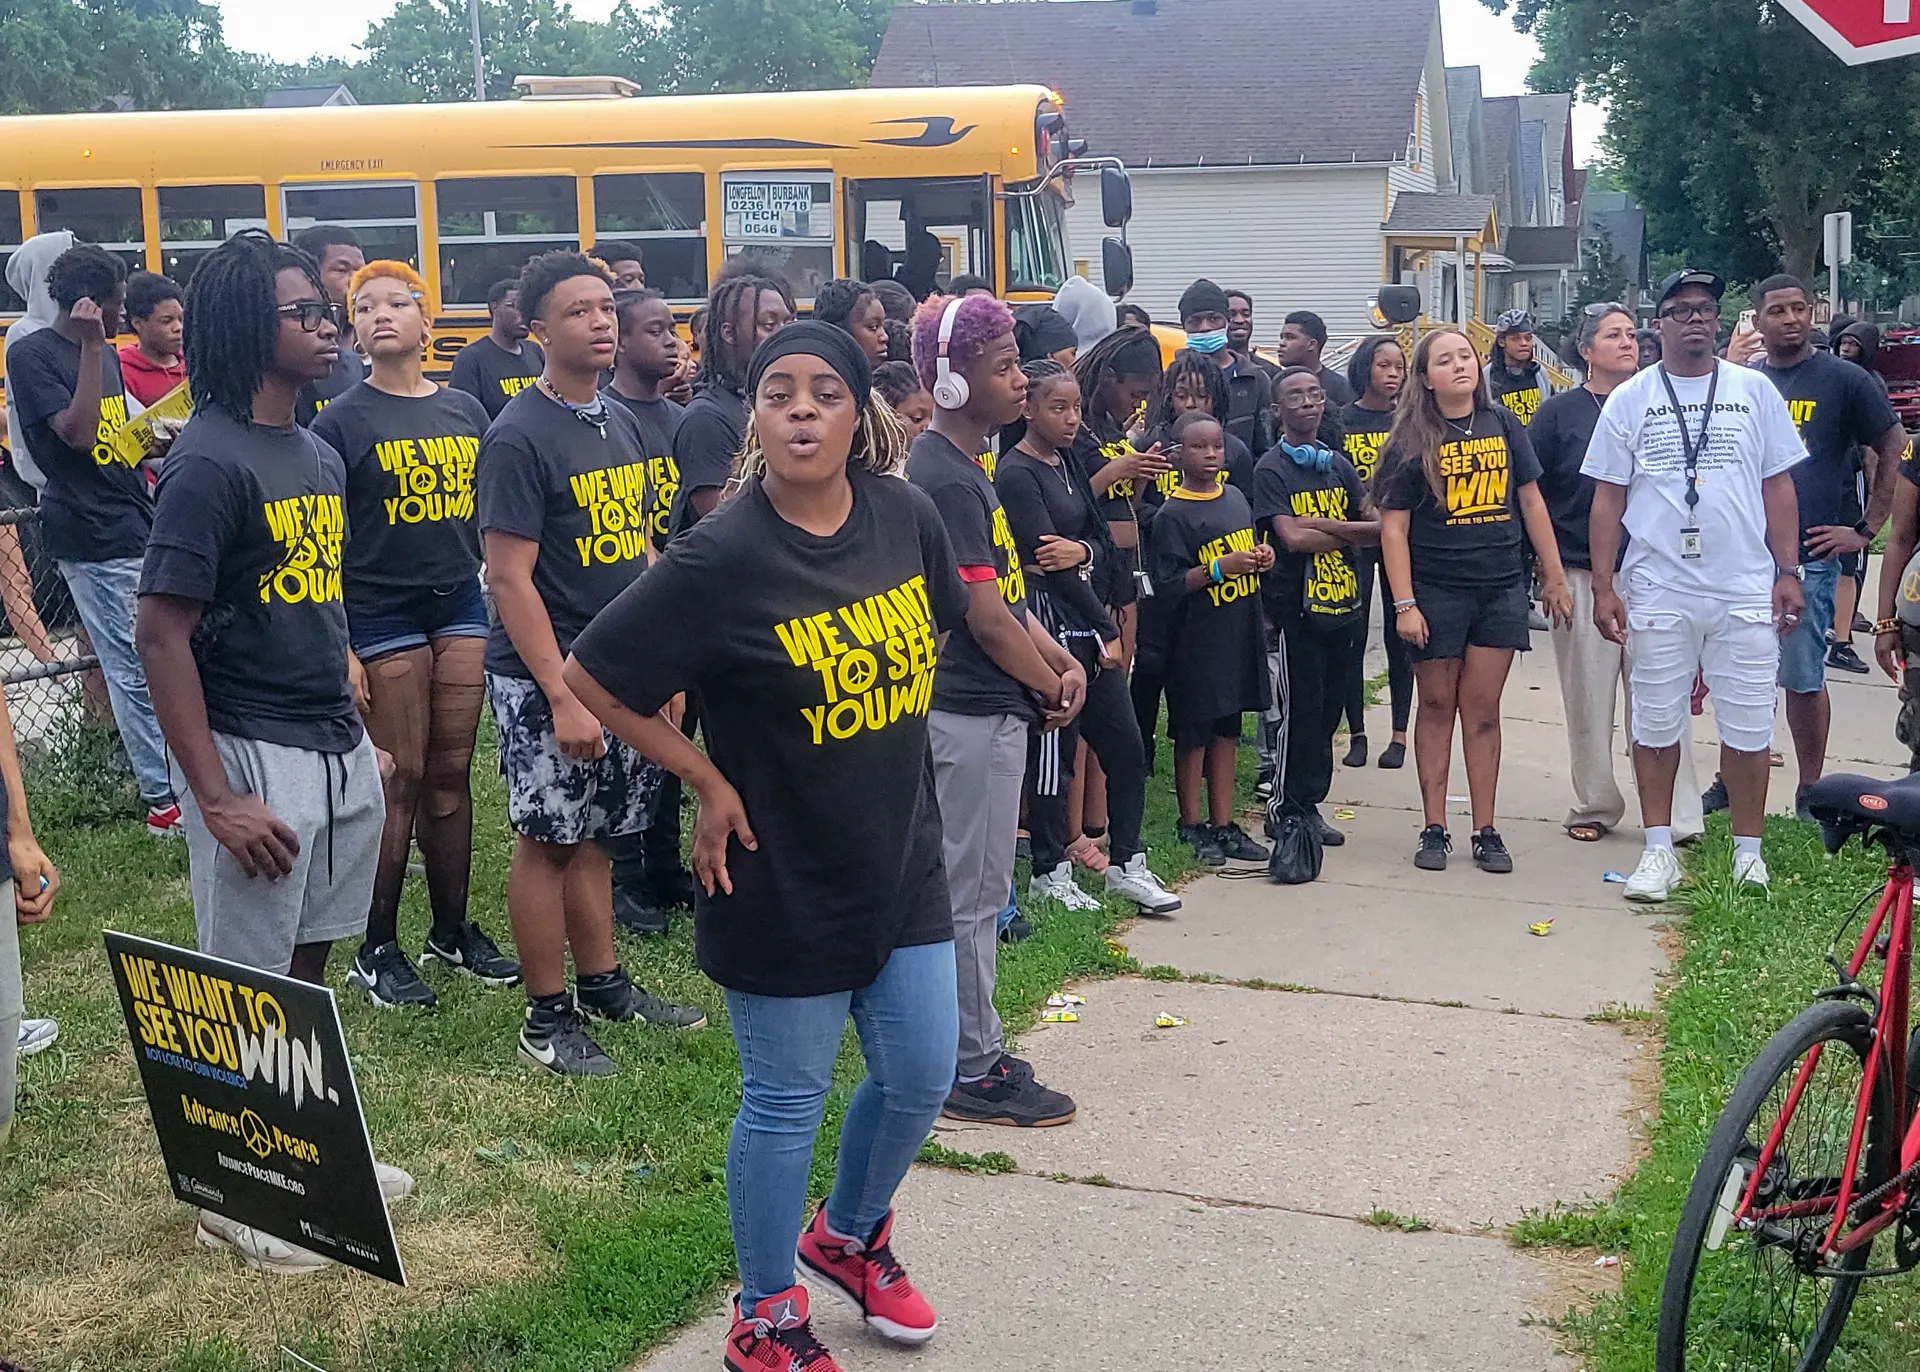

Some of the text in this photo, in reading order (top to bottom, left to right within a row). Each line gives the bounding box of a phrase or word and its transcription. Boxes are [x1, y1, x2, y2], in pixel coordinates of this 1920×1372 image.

[320, 158, 384, 171] EMERGENCY EXIT
[728, 185, 767, 200] LONGFELLOW
[731, 200, 764, 210] 0236
[772, 186, 809, 200] BURBANK
[774, 201, 807, 211] 0718
[744, 223, 778, 234] 0646
[745, 210, 780, 220] TECH
[1501, 388, 1540, 407] WE WAN
[1645, 402, 1750, 418] Advancpate
[1785, 400, 1817, 422] NT
[375, 438, 420, 473] WE
[1349, 446, 1379, 466] TO
[1440, 436, 1507, 458] WE WANNA
[1440, 450, 1508, 477] SEE YOU
[394, 465, 438, 497] TO
[569, 469, 611, 508] WE
[1446, 468, 1509, 513] WIN
[264, 494, 344, 542] WE WAN
[383, 493, 444, 526] YOU
[588, 500, 626, 535] TO
[575, 529, 634, 567] YOU
[1207, 575, 1249, 607] YOU
[774, 574, 932, 667] WE WANT
[812, 622, 938, 703] TO SEE
[800, 686, 887, 745] YOU
[119, 952, 287, 1040] WE WANT TO
[133, 1000, 340, 1112] SEE YOU WIN.
[180, 1093, 321, 1166] Advance Peace
